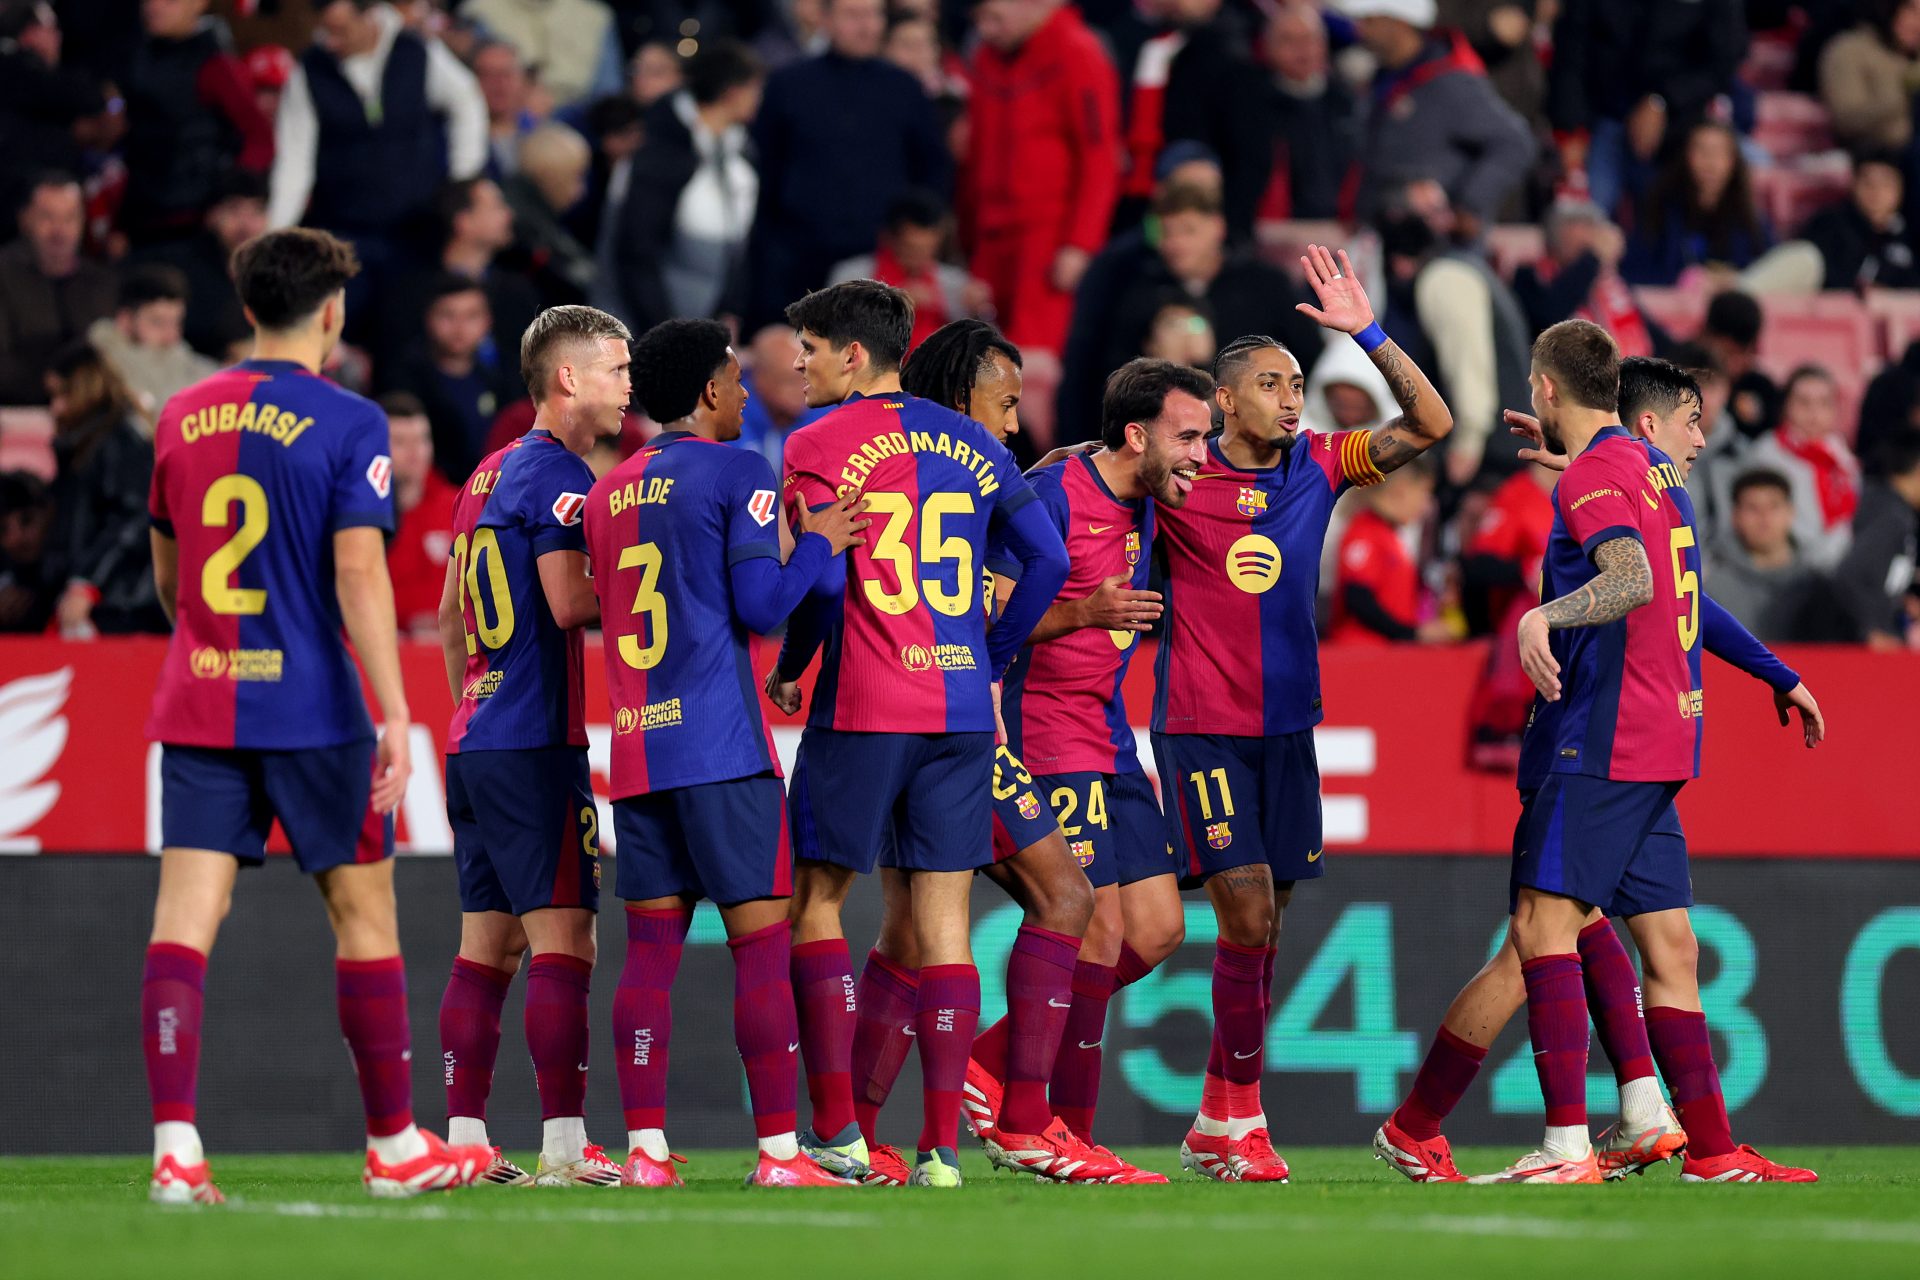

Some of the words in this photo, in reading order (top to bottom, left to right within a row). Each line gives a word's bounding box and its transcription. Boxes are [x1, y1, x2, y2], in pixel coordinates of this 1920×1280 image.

[181, 402, 314, 447] CUBARSÍ
[609, 478, 674, 517] BALDE
[1570, 488, 1612, 511] AMBILIGHT
[202, 474, 269, 615] 2
[861, 491, 976, 617] 35
[454, 527, 515, 657] 20
[616, 541, 669, 671] 3
[1669, 525, 1699, 652] 5
[931, 644, 972, 657] UNHCR
[934, 654, 976, 667] ACNUR
[640, 709, 682, 727] ACNUR
[641, 697, 681, 716] UNHCR
[1050, 780, 1108, 837] 24
[1190, 768, 1235, 820] 11
[444, 1050, 457, 1086] BARÇA
[634, 1028, 654, 1066] BARÇA
